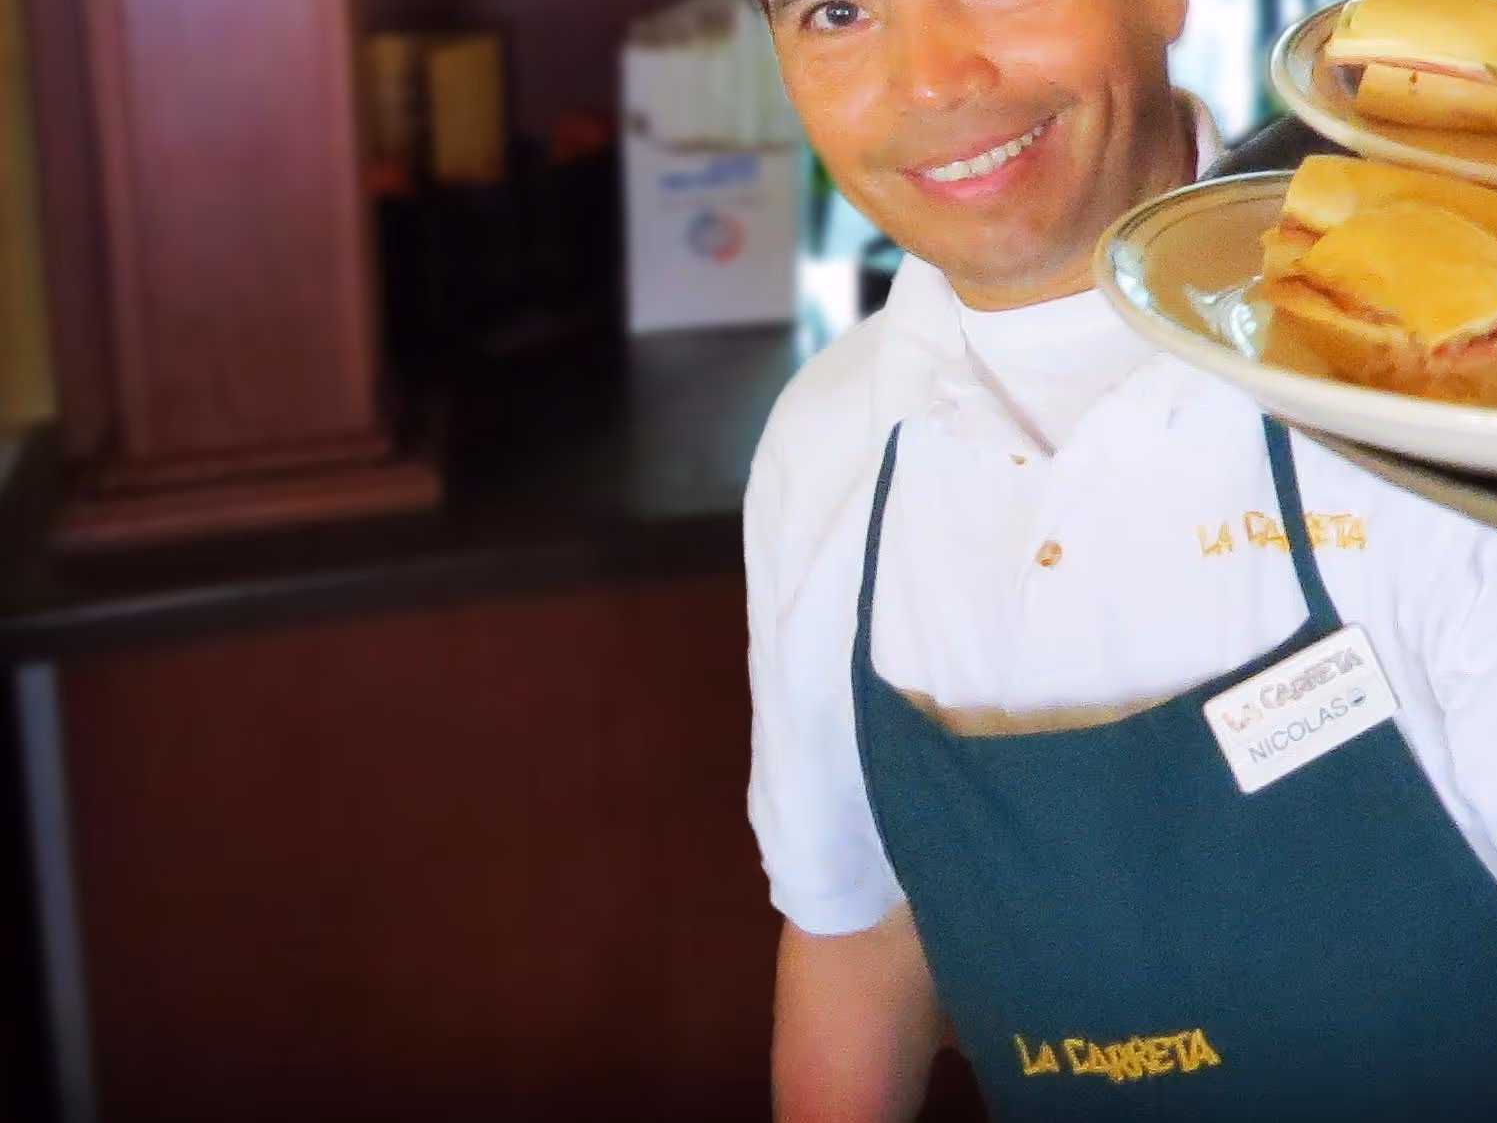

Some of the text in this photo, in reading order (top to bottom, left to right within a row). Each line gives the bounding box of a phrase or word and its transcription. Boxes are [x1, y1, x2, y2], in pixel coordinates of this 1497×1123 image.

[1196, 518, 1234, 557] LA
[1247, 696, 1349, 764] NICOLAS
[1013, 1028, 1222, 1084] LA CARRETA
